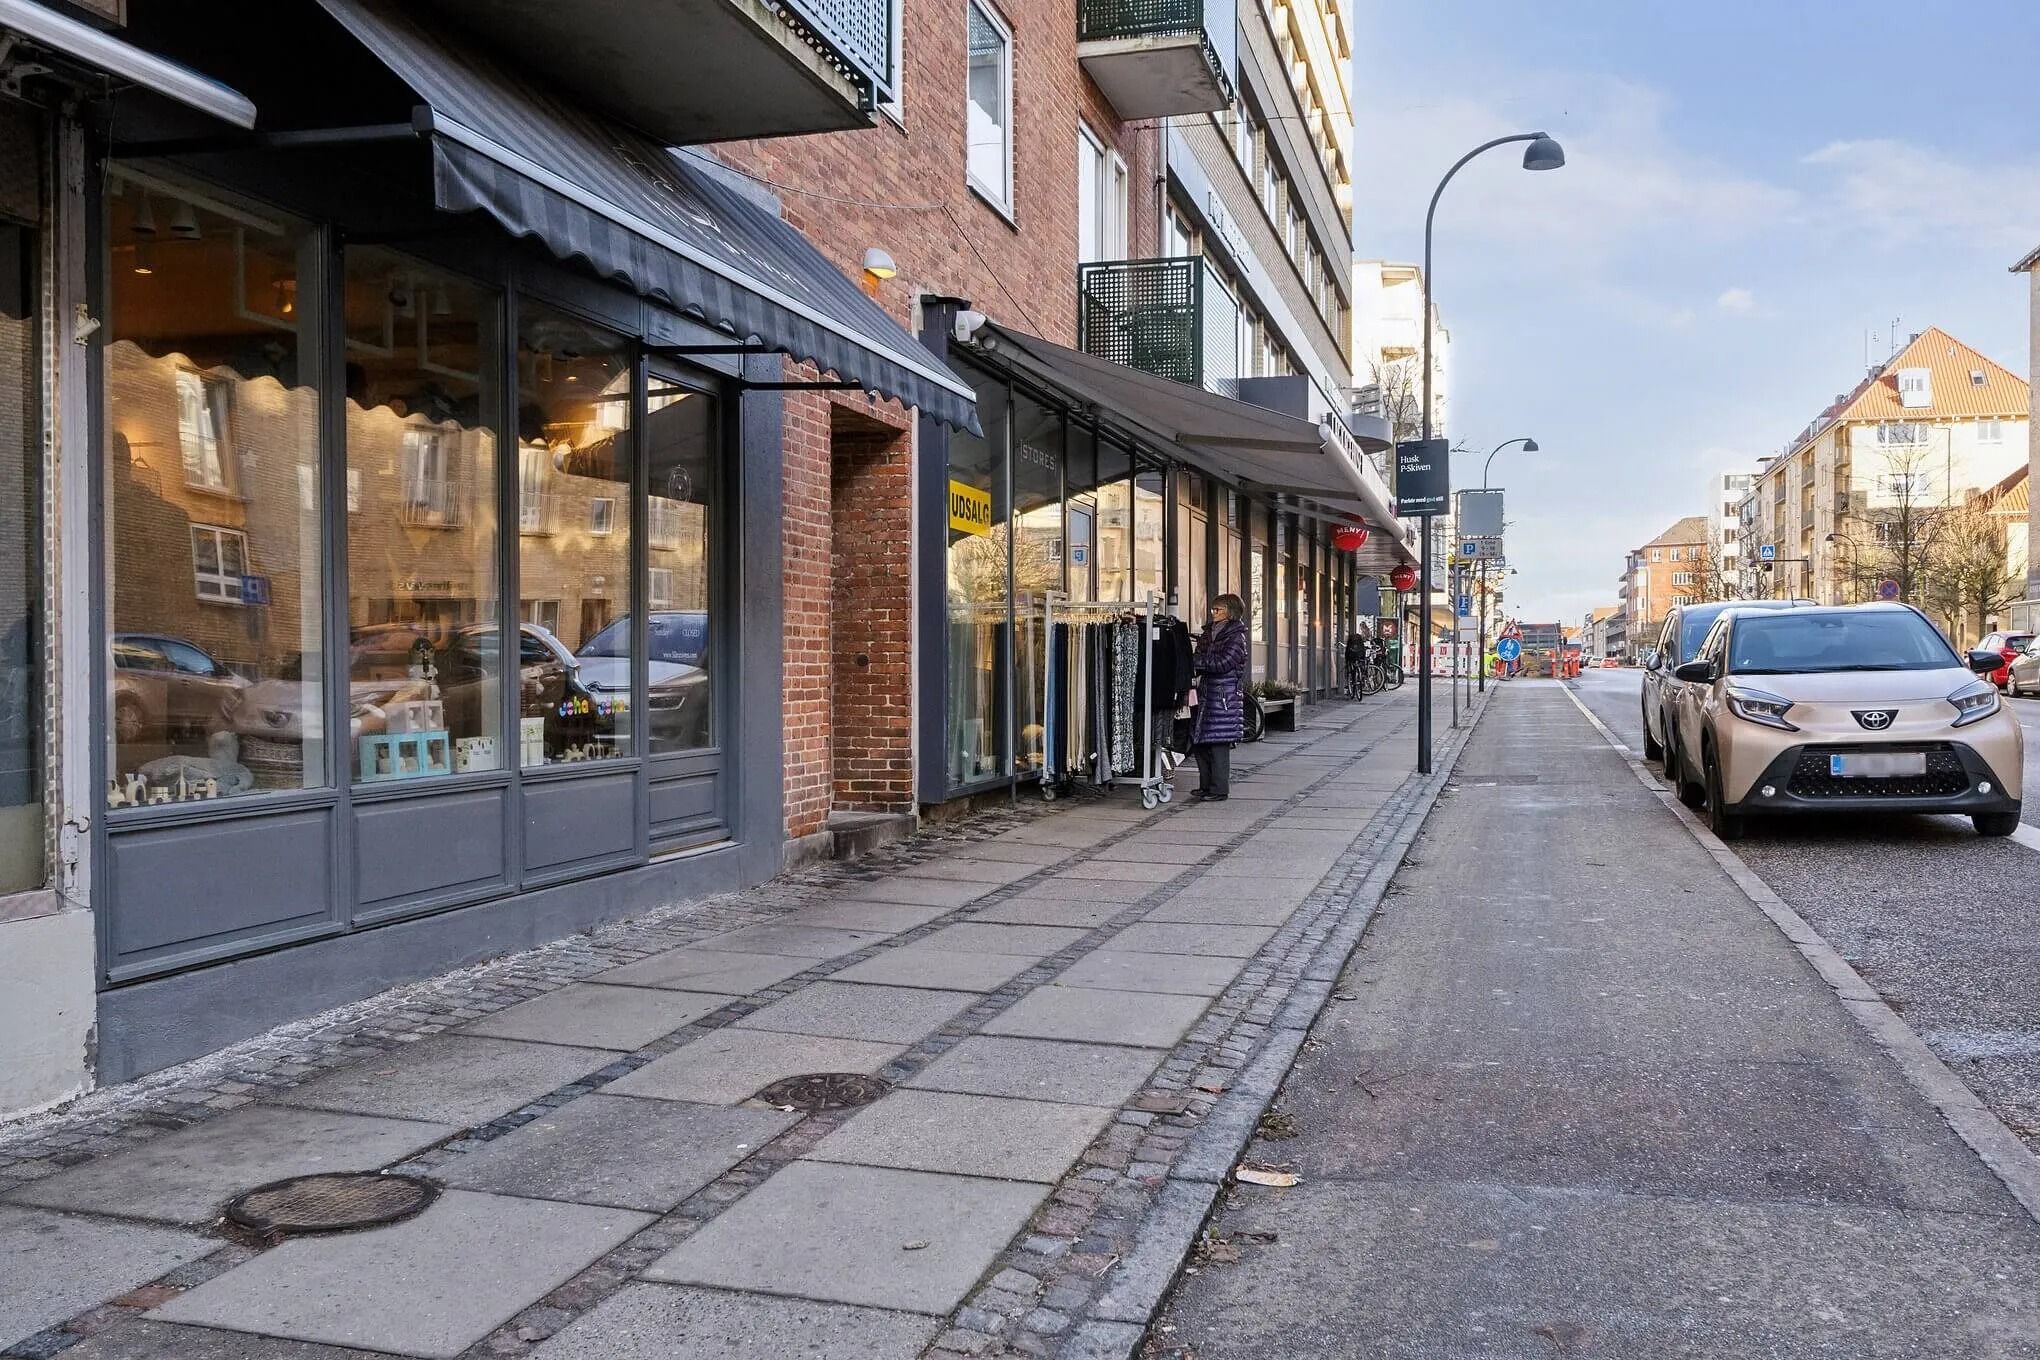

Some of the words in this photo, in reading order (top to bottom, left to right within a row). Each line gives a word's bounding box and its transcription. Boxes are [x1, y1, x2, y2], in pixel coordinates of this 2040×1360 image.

[1400, 455, 1420, 464] Husk
[1400, 463, 1431, 473] P-Skiven
[951, 493, 990, 525] UDSALG
[1336, 526, 1362, 535] MENY
